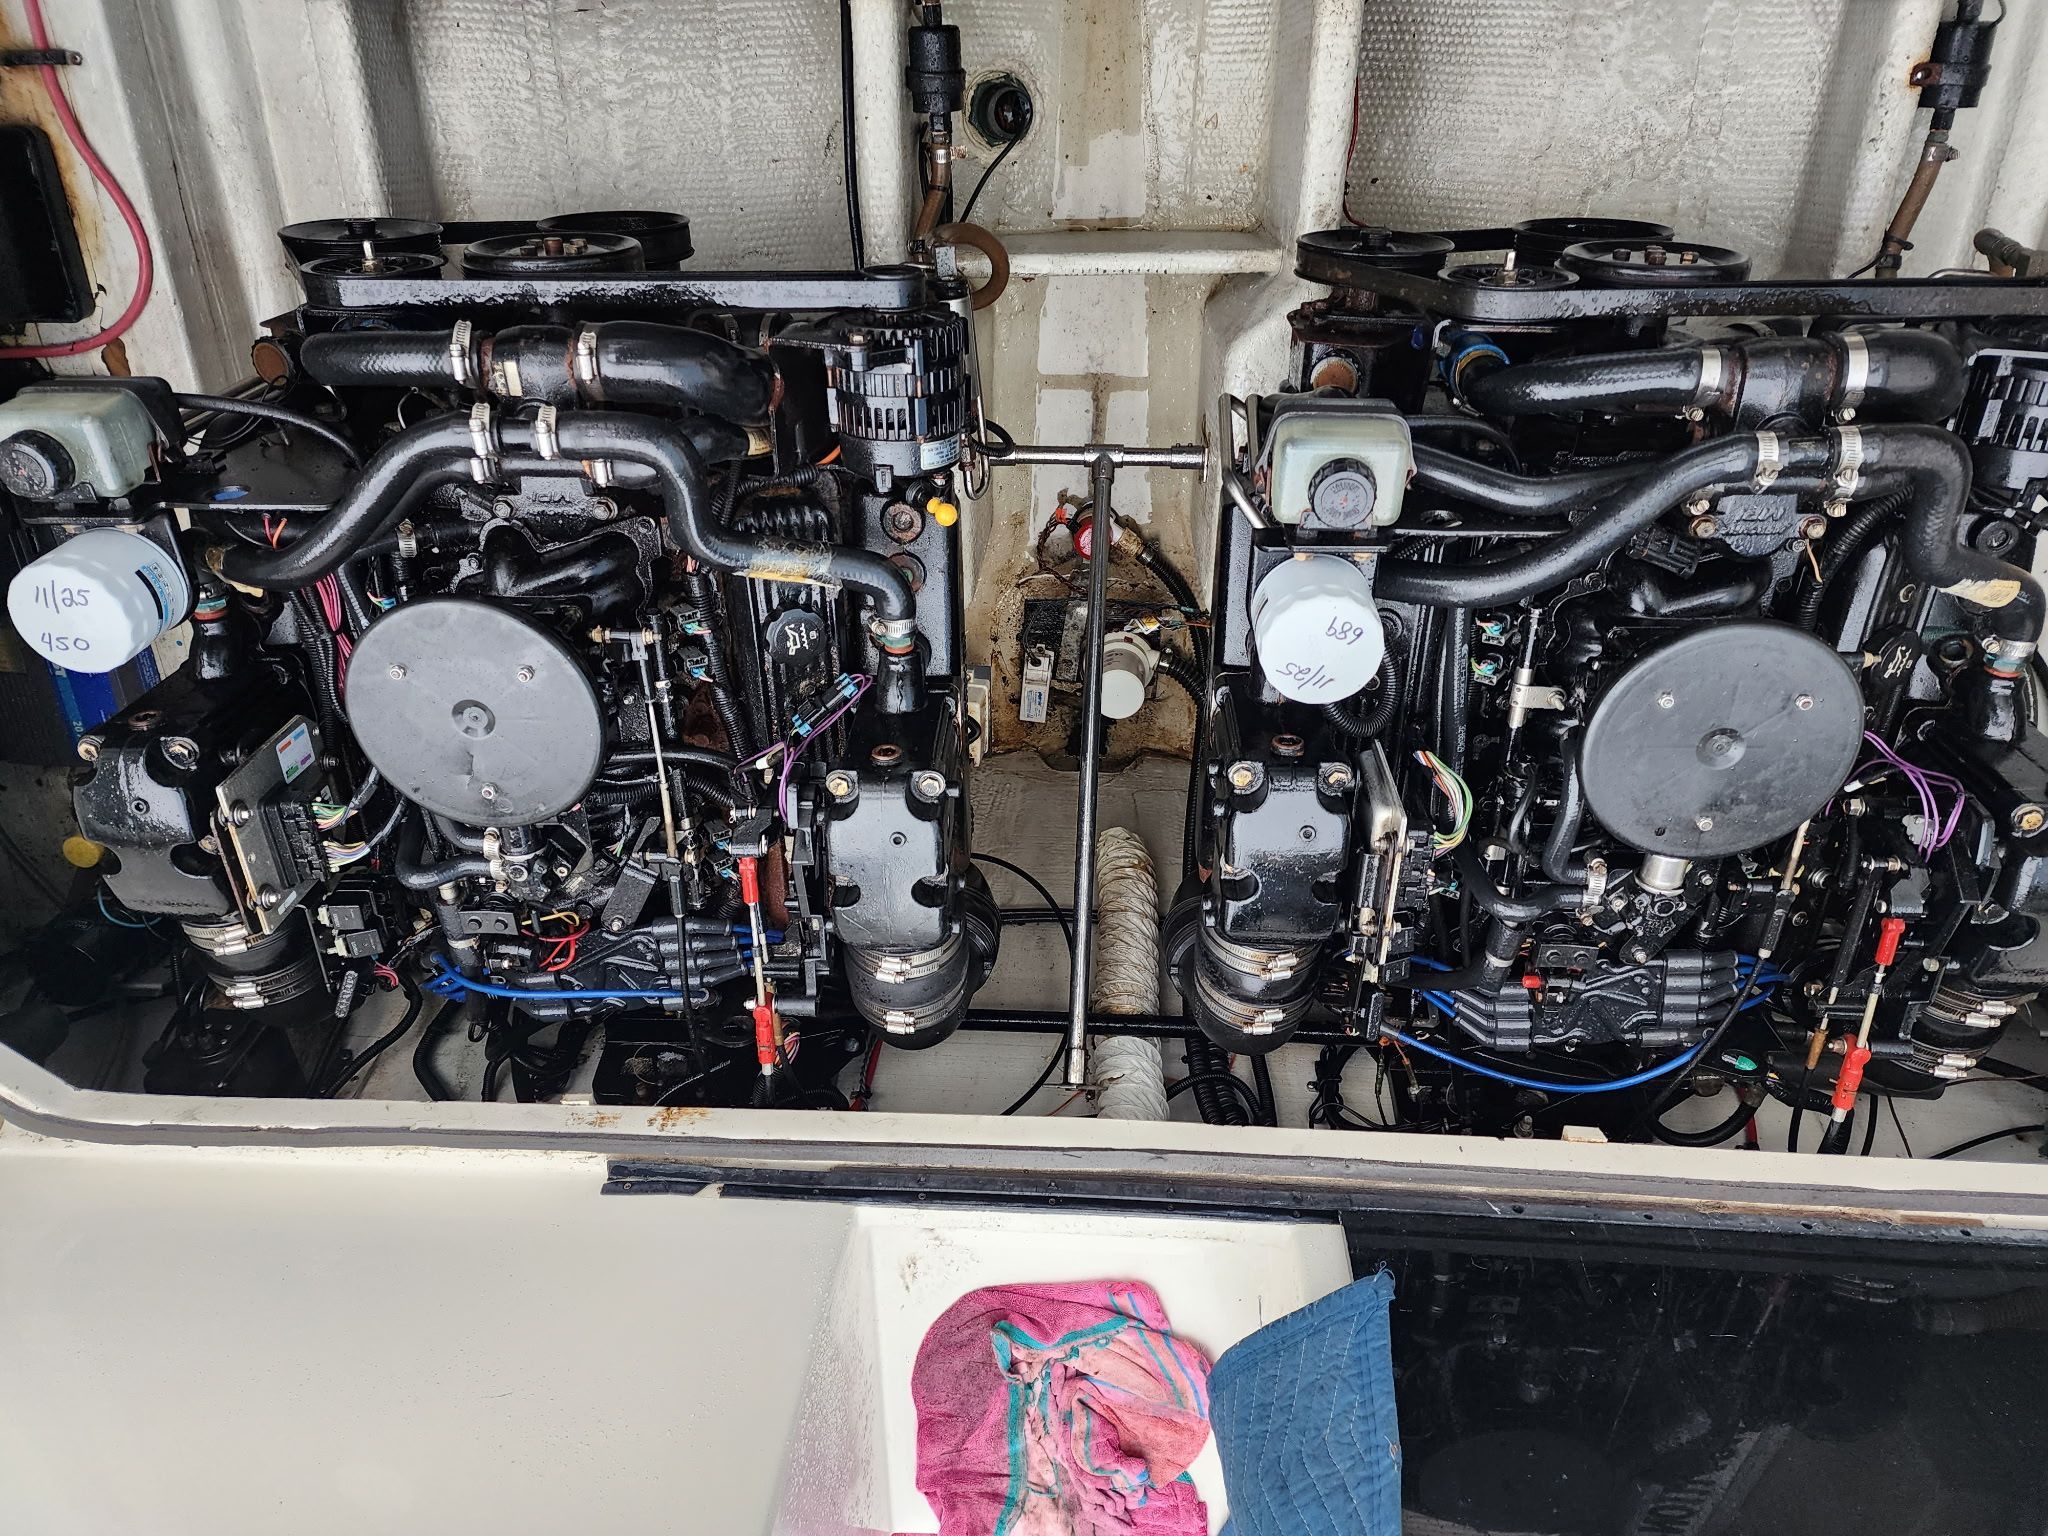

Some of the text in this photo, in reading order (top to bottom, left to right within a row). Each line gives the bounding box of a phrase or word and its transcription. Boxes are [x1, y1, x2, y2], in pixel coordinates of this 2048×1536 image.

[35, 579, 91, 614] 11/25
[40, 632, 90, 652] 450
[1325, 616, 1364, 645] 689
[1275, 662, 1335, 690] 11/25
